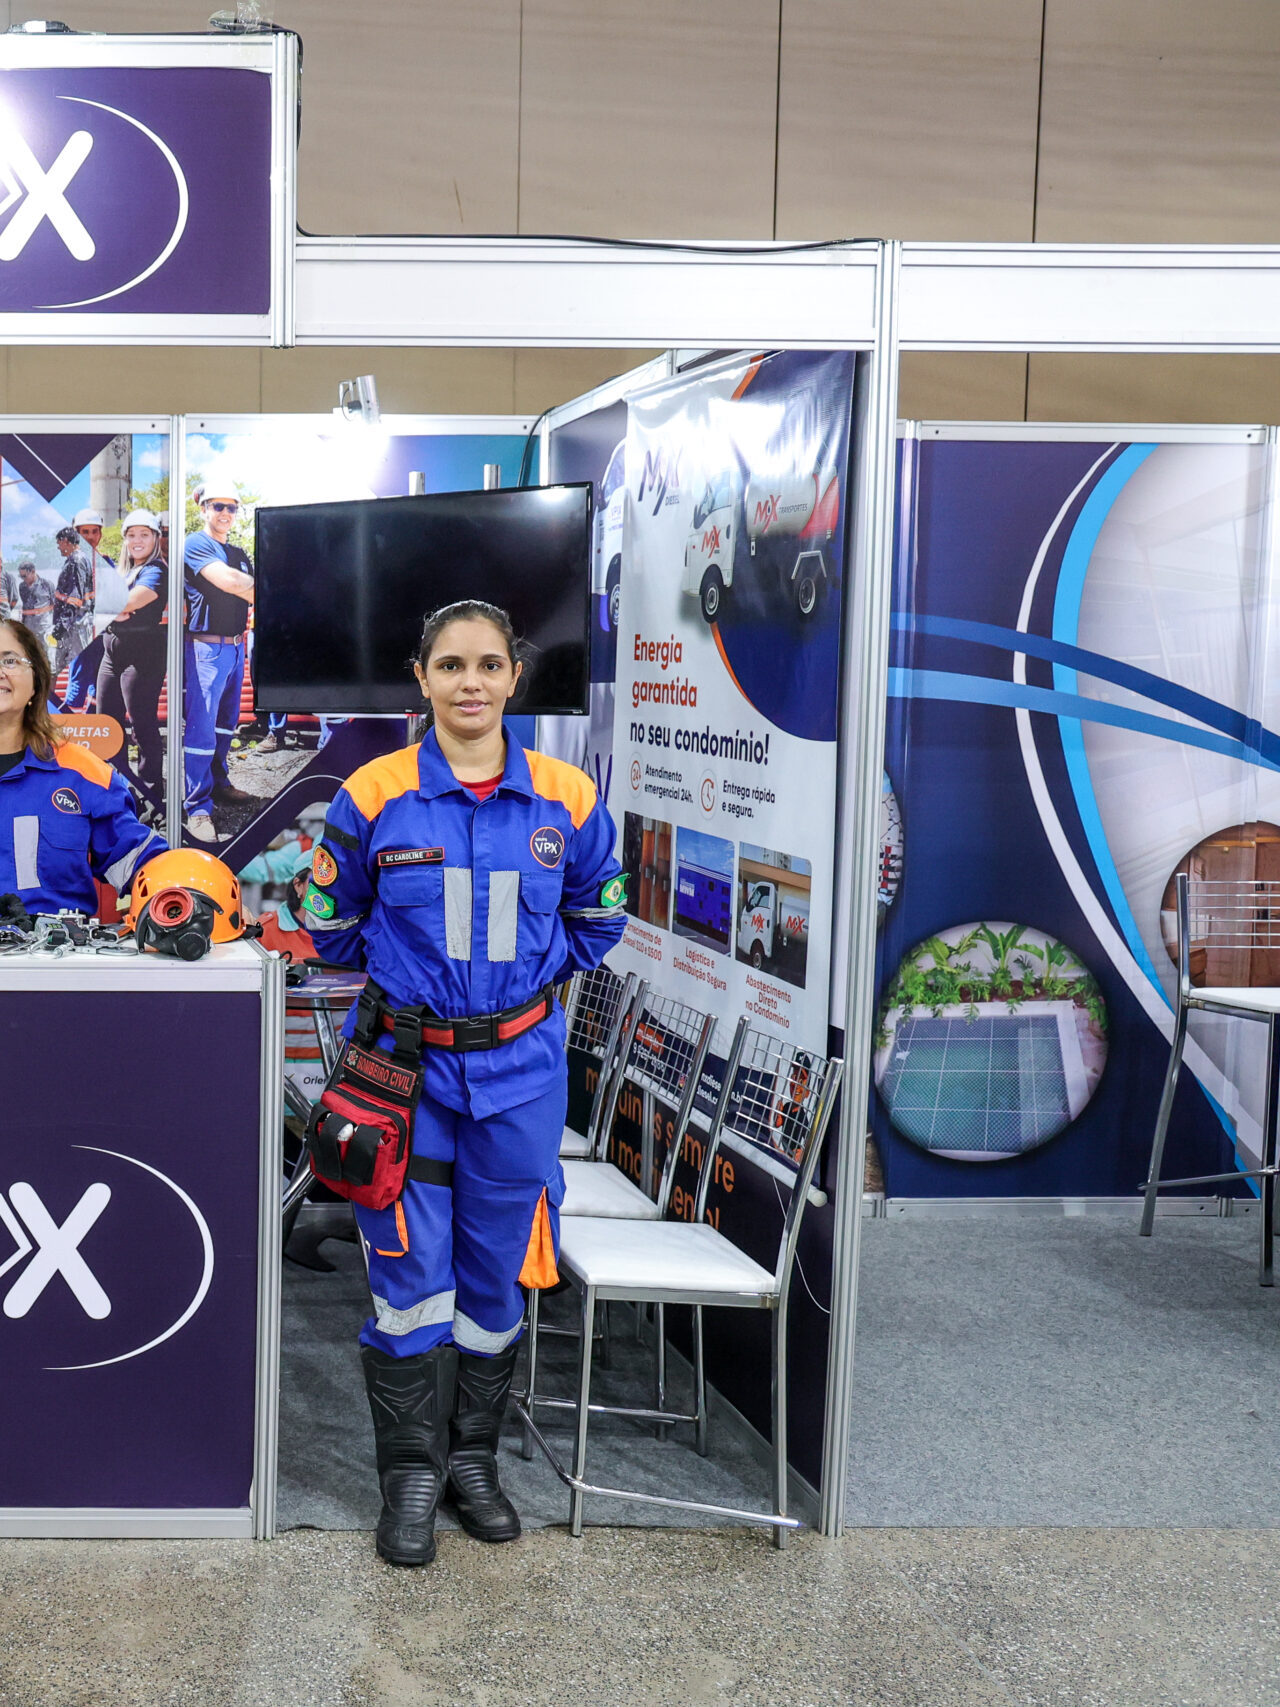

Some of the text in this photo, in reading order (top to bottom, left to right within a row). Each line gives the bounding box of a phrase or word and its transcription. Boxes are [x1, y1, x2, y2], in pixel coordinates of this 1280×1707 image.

[633, 634, 682, 670] Energia
[632, 677, 697, 708] garantida
[630, 722, 769, 765] no seu condomínio!
[645, 764, 682, 782] Atendimento
[645, 783, 693, 803] emergencial 24h.
[723, 780, 775, 803] Entrega rápida
[56, 796, 75, 809] VPX
[722, 802, 754, 818] e segura.
[395, 852, 423, 861] CAROLINE
[535, 842, 558, 854] VPX
[654, 934, 662, 945] de
[686, 947, 715, 968] Logística e
[673, 957, 726, 990] Distribuição Segura
[746, 974, 792, 1003] Abastecimento
[759, 992, 777, 1009] Direto
[745, 1000, 789, 1028] no Condomínio
[356, 1055, 410, 1091] BOMBEIRO CIVIL
